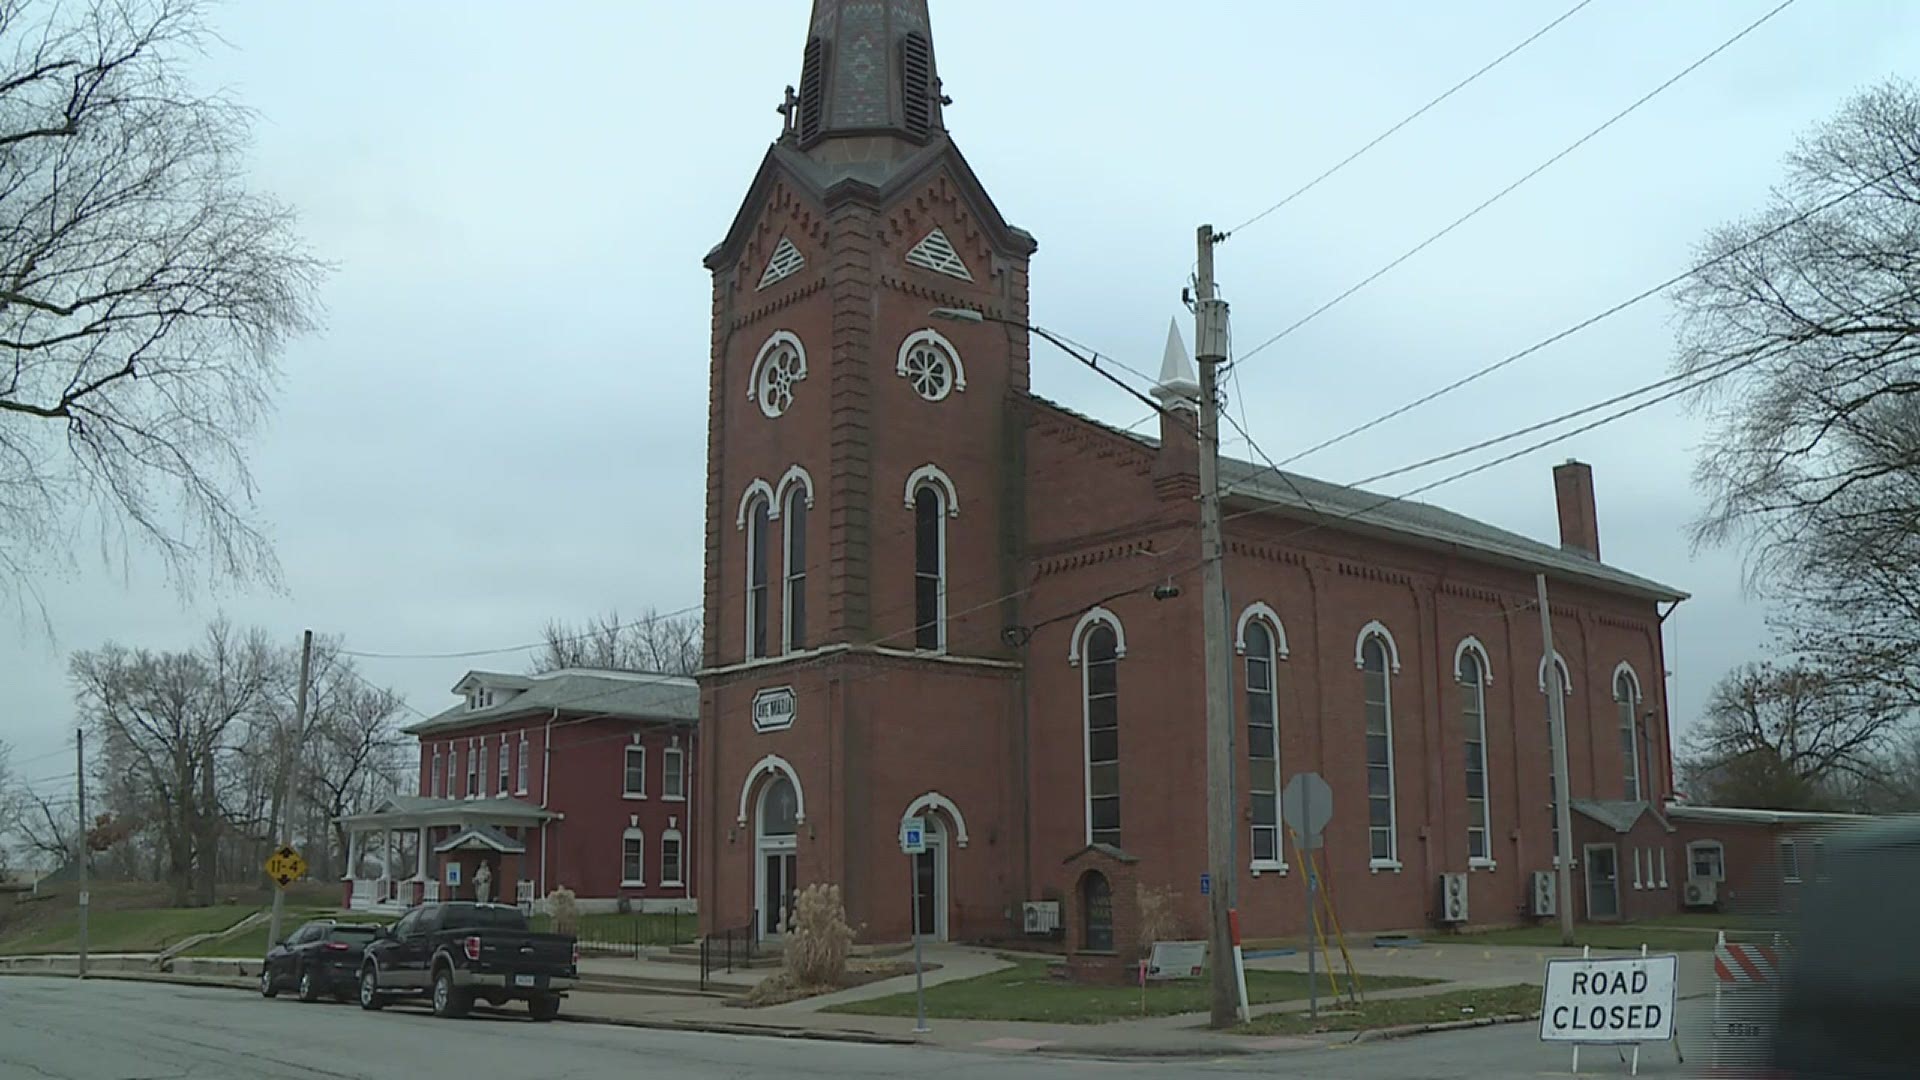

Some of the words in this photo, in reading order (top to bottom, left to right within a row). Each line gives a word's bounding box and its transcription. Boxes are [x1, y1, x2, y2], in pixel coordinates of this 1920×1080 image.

[757, 702, 769, 718] AVE
[1572, 970, 1648, 995] ROAD
[1552, 1004, 1662, 1030] CLOSED
